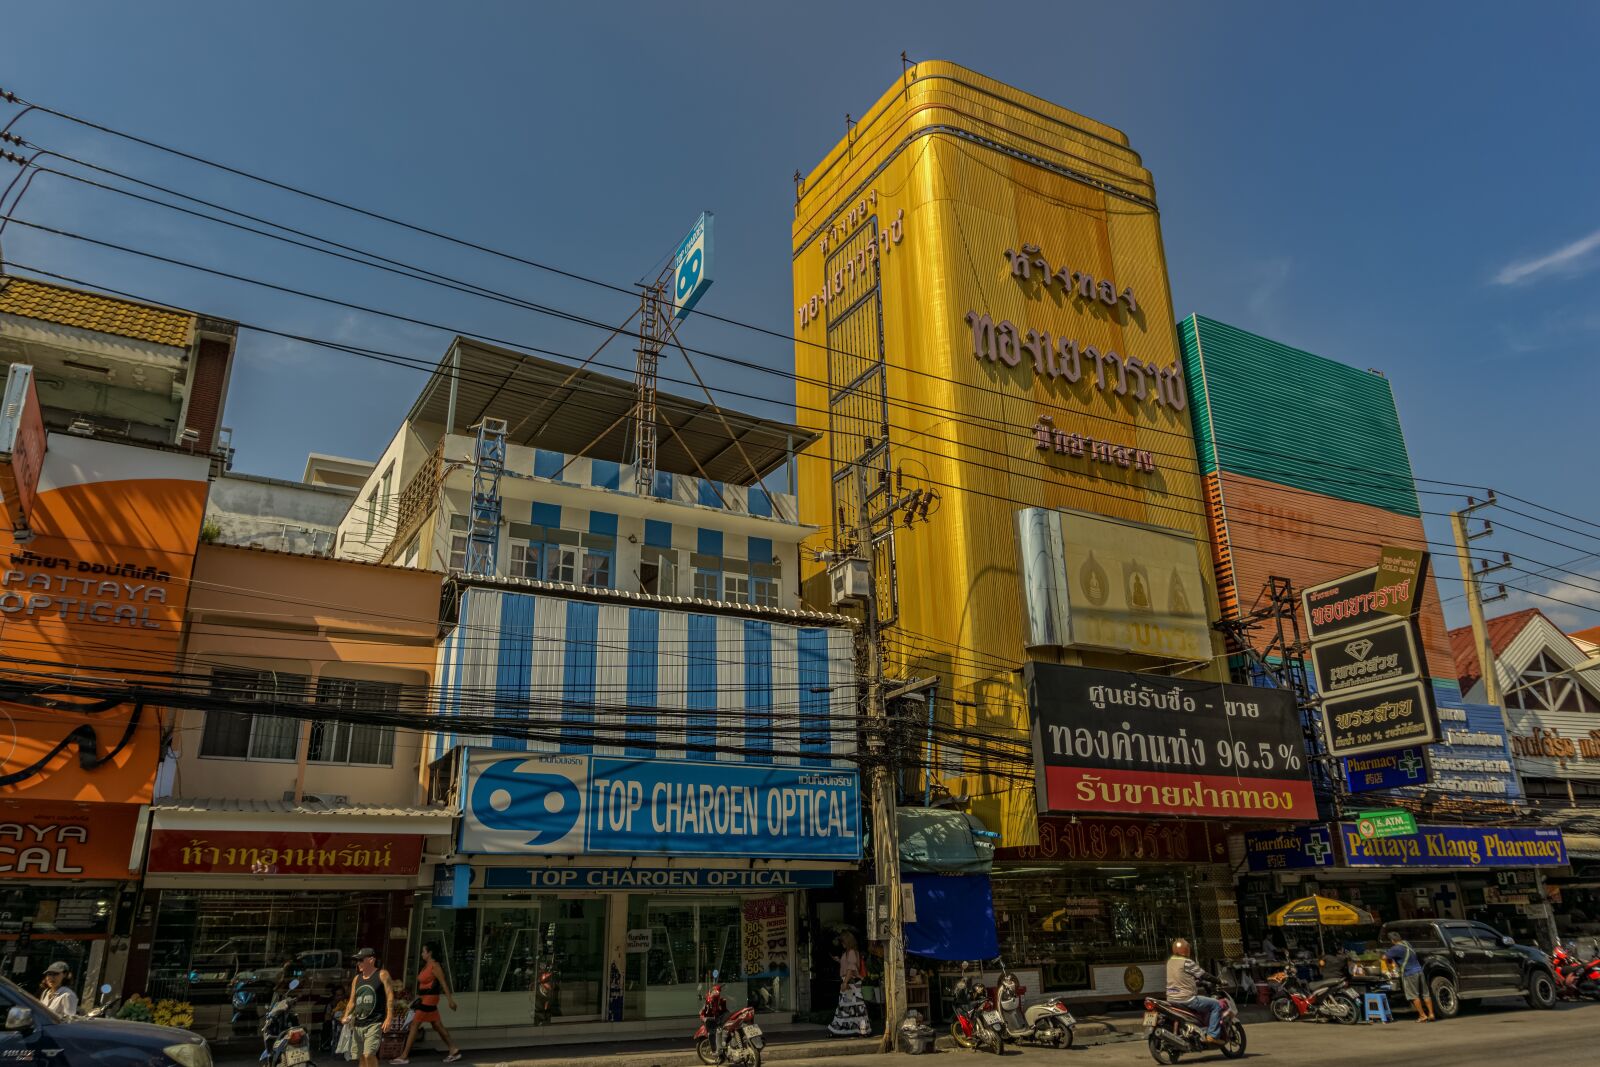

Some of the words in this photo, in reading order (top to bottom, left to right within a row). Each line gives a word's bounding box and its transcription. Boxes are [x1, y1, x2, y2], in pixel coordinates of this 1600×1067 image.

[1004, 242, 1138, 313] ห้างทอง
[964, 310, 1187, 412] ทองเยาวราช
[2, 569, 167, 604] PATTAYA
[0, 592, 161, 629] OPTICAL
[1088, 683, 1196, 713] ศูนย์รับซื้อ
[1224, 700, 1260, 718] ขาย
[1049, 721, 1206, 766] ทองคำแท่ง
[1347, 754, 1398, 774] Pharmacy
[594, 779, 643, 832] TOP
[651, 783, 758, 836] CHAROEN
[767, 788, 855, 838] OPTICAL
[1075, 774, 1293, 811] รับขายฝากทอง
[180, 839, 393, 867] ห้างทองนพรัตน์
[1349, 832, 1421, 863] Pattaya
[1425, 833, 1480, 865] Klang
[1483, 833, 1563, 863] Pharmacy
[527, 870, 578, 886] TOP
[586, 870, 698, 886] CHAROEN
[706, 870, 797, 886] OPTICAL
